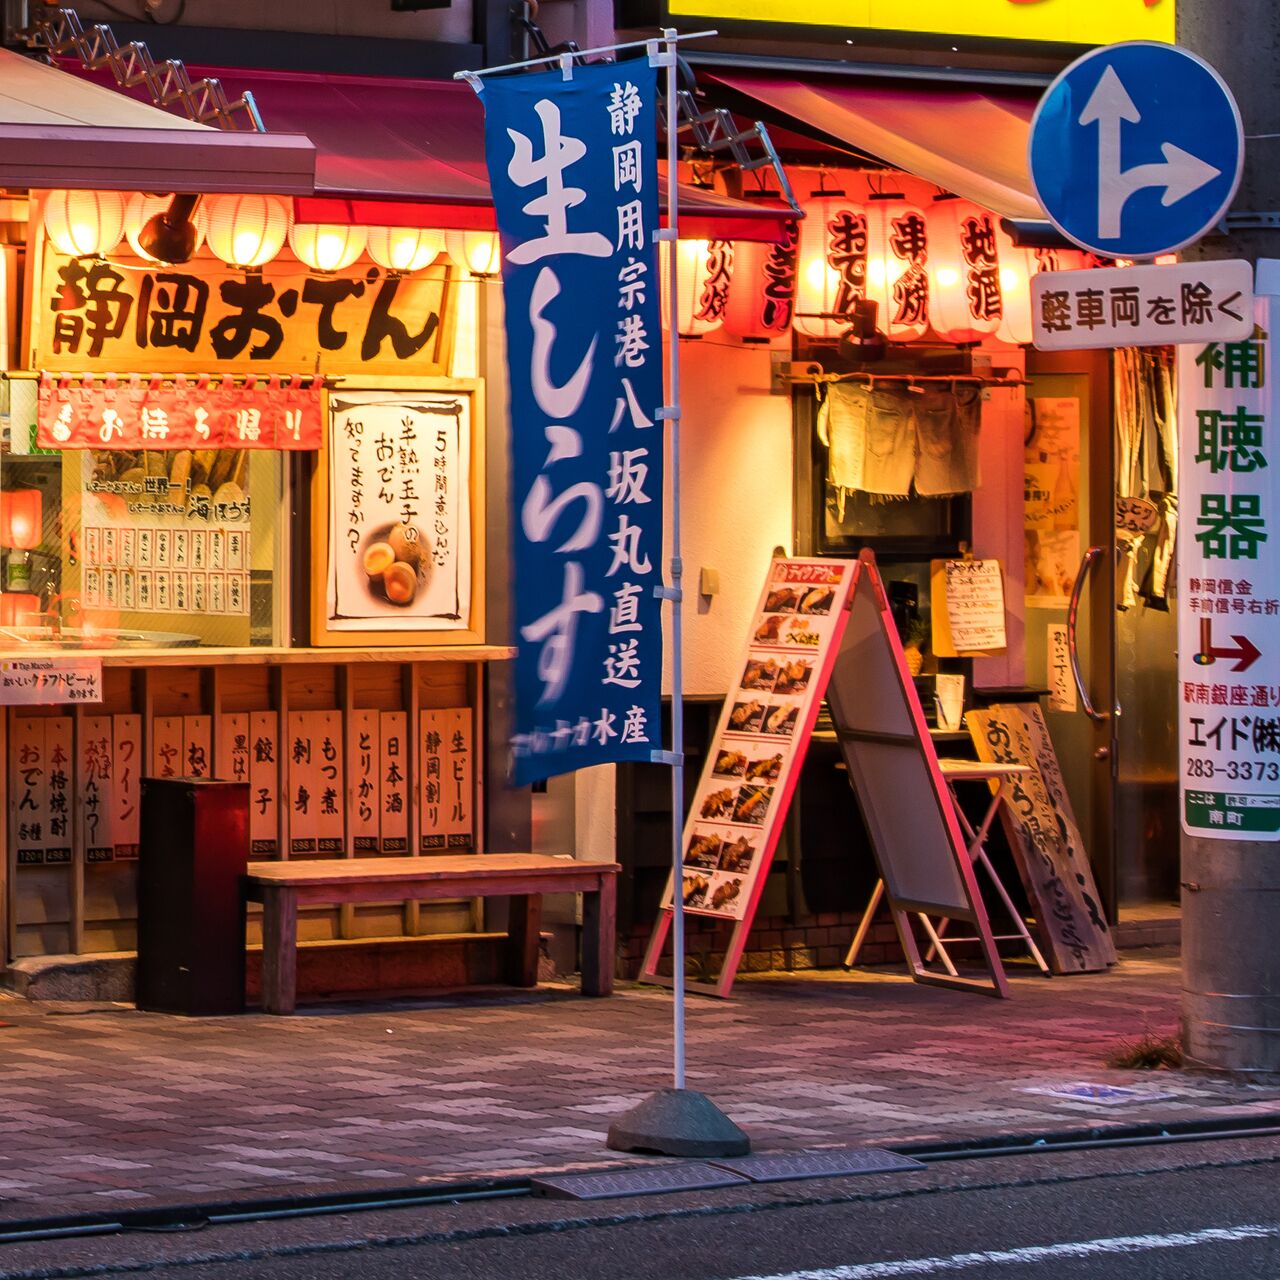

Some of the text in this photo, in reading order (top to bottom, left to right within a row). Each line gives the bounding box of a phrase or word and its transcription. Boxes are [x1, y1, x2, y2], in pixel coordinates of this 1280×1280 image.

[50, 257, 440, 362] 静岡おでん
[1041, 280, 1245, 334] 軽車両を除く
[98, 407, 304, 442] お持ち帰り
[504, 97, 615, 706] 生しらす
[601, 81, 654, 690] 静岡用宗港八坂丸直送
[374, 431, 394, 505] おでん
[1194, 324, 1269, 560] 補聴器
[1189, 577, 1253, 596] 静岡信金
[1189, 598, 1280, 616] 手前信号右折
[3, 673, 96, 688] おいしいクラフトビール
[68, 688, 100, 700] あります。
[1183, 681, 1280, 708] 駅南銀座通り
[19, 744, 41, 811] おでん
[49, 743, 68, 838] 本格焼酎
[84, 739, 101, 845] みかんサワー
[119, 739, 135, 821] ワイン
[252, 736, 275, 816] 餃子
[291, 736, 311, 816] 刺身
[320, 736, 339, 815] もつ煮
[357, 731, 374, 823] とりから
[384, 736, 403, 814] 日本酒
[424, 730, 443, 828] 静岡割り
[449, 729, 468, 823] 生ビール
[1187, 757, 1279, 781] 283-3373
